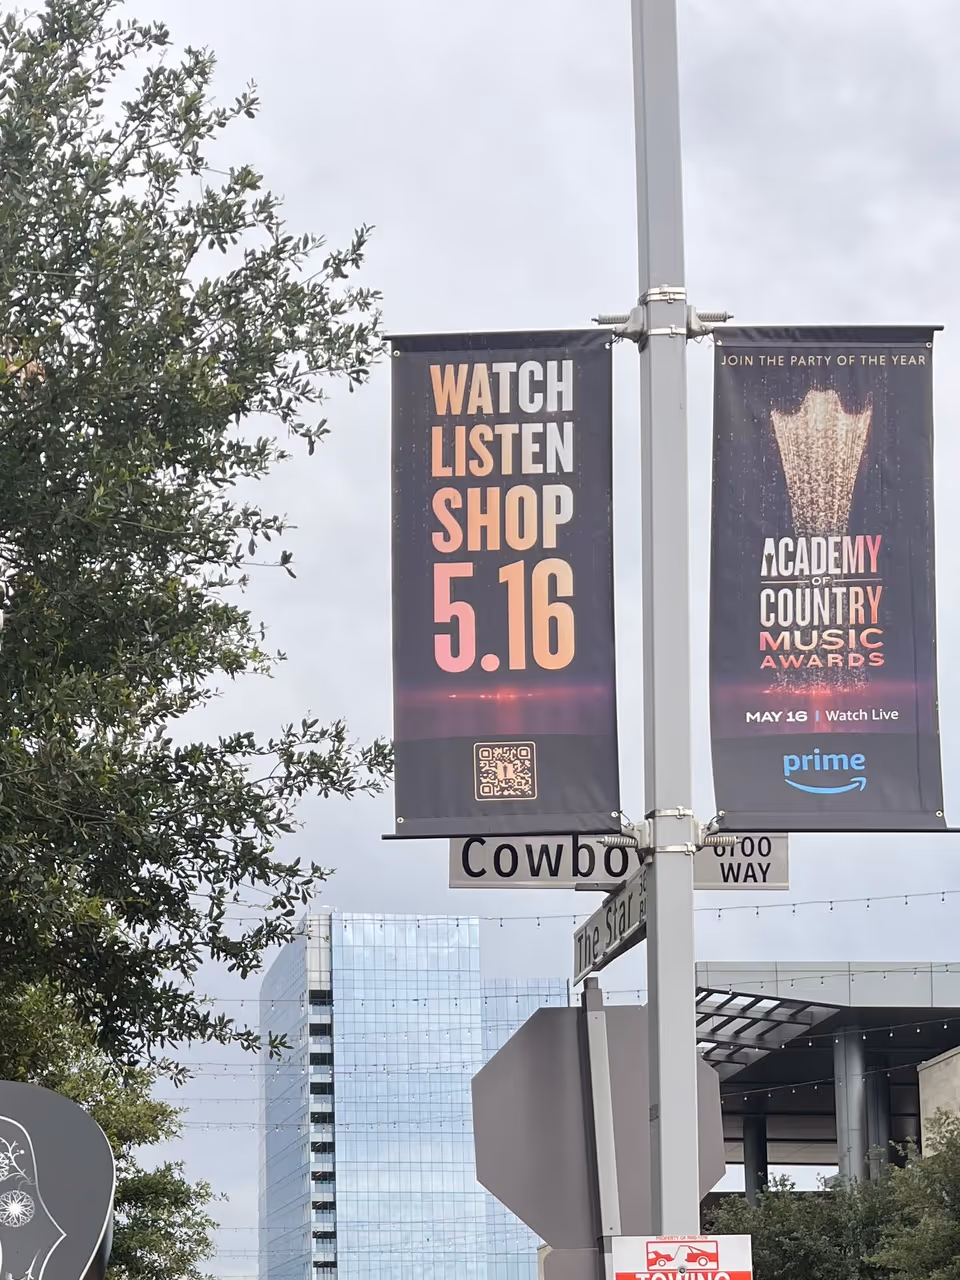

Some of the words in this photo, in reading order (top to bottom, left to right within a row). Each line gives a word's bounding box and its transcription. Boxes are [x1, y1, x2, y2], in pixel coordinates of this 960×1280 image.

[721, 355, 754, 366] JOIN
[759, 355, 784, 366] THE
[790, 355, 832, 366] PARTY
[837, 355, 855, 366] OF
[860, 355, 886, 366] THE
[891, 355, 926, 366] YEAR
[429, 360, 574, 416] WATCH
[431, 421, 574, 477] LISTEN
[431, 484, 574, 553] SHOP
[760, 535, 882, 577] ACADEMY
[811, 576, 831, 585] OF
[433, 557, 575, 673] 5.16
[759, 586, 883, 628] COUNTRY
[759, 628, 884, 651] MUSIC
[760, 652, 885, 670] AWARDS
[746, 711, 784, 723] MAY
[786, 711, 808, 723] 16
[826, 709, 868, 722] Watch
[872, 708, 899, 721] Live
[783, 749, 866, 776] prime
[720, 863, 771, 883] WAY
[577, 926, 600, 973] The
[605, 892, 634, 950] Star
